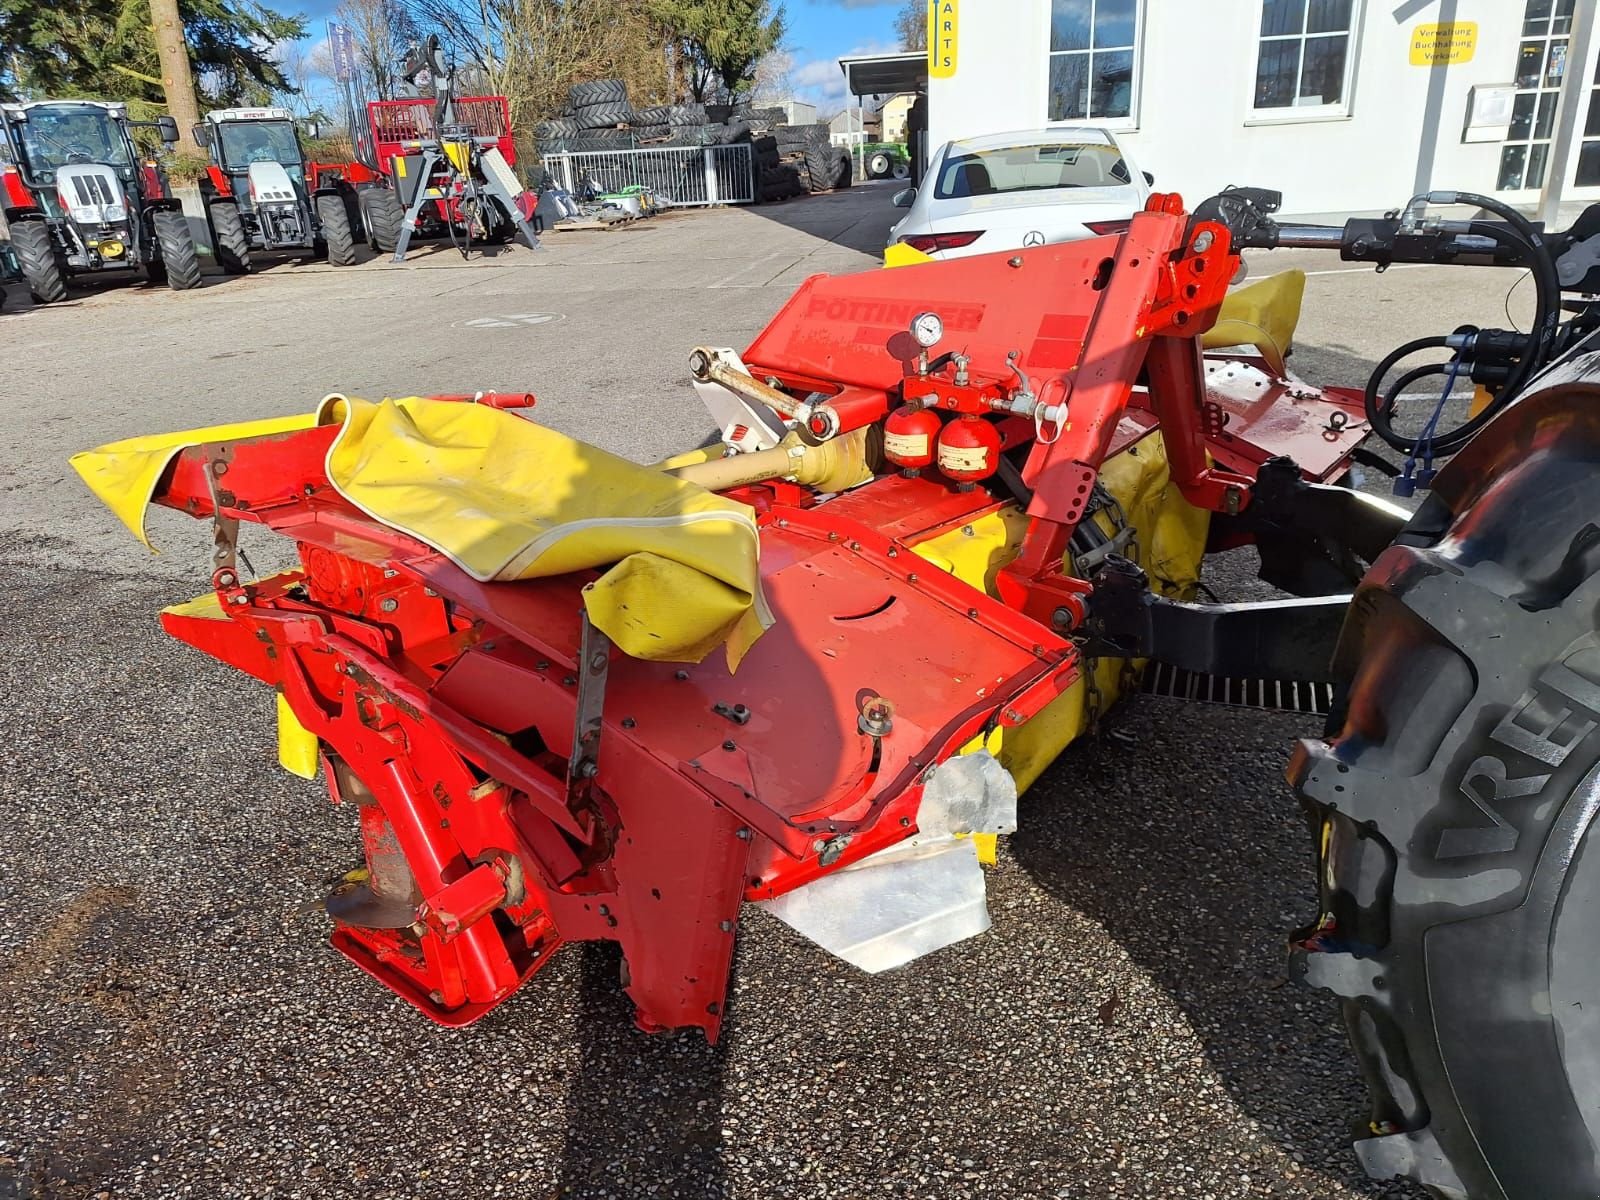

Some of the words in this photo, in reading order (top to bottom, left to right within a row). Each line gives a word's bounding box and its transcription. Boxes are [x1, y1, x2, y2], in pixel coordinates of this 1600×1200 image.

[943, 3, 953, 67] ARTS
[1420, 28, 1472, 36] Verwaltung
[1415, 40, 1472, 49] Buchhaltung
[1425, 51, 1460, 60] Verkauf
